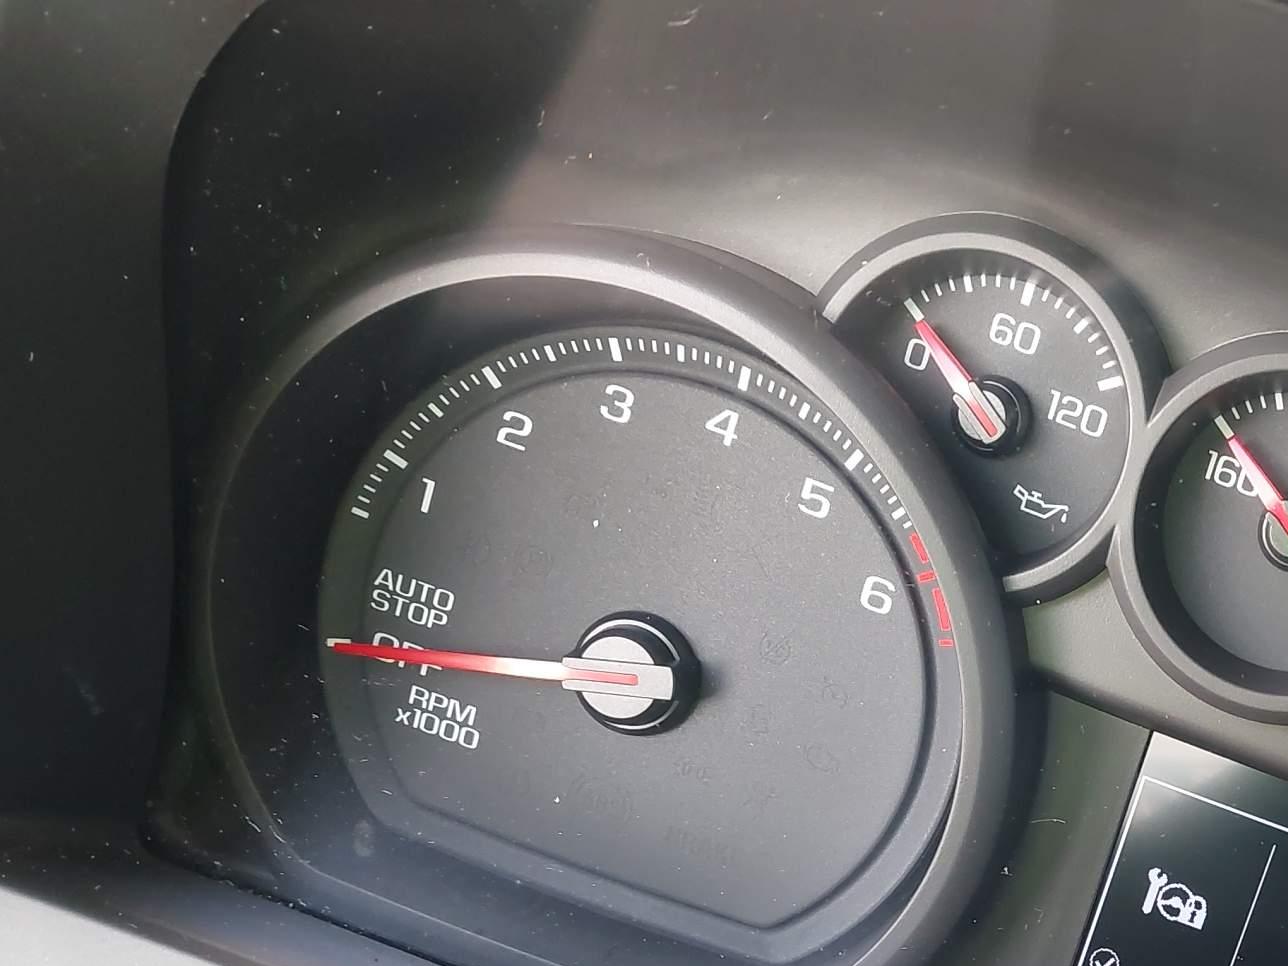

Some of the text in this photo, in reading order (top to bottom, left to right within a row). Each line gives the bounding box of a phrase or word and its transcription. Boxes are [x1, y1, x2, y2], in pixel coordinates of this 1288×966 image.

[904, 338, 931, 370] 0
[988, 313, 1040, 355] 60
[600, 384, 635, 423] 3
[1046, 389, 1108, 437] 120
[496, 411, 533, 451] 2
[705, 408, 739, 446] 4
[1205, 450, 1259, 497] 160
[420, 478, 436, 513] 1
[798, 477, 834, 519] 5
[370, 589, 448, 628] STOP
[374, 568, 455, 612] AUTO
[860, 575, 896, 615] 6
[408, 685, 477, 726] RPM
[395, 708, 480, 749] x1000
